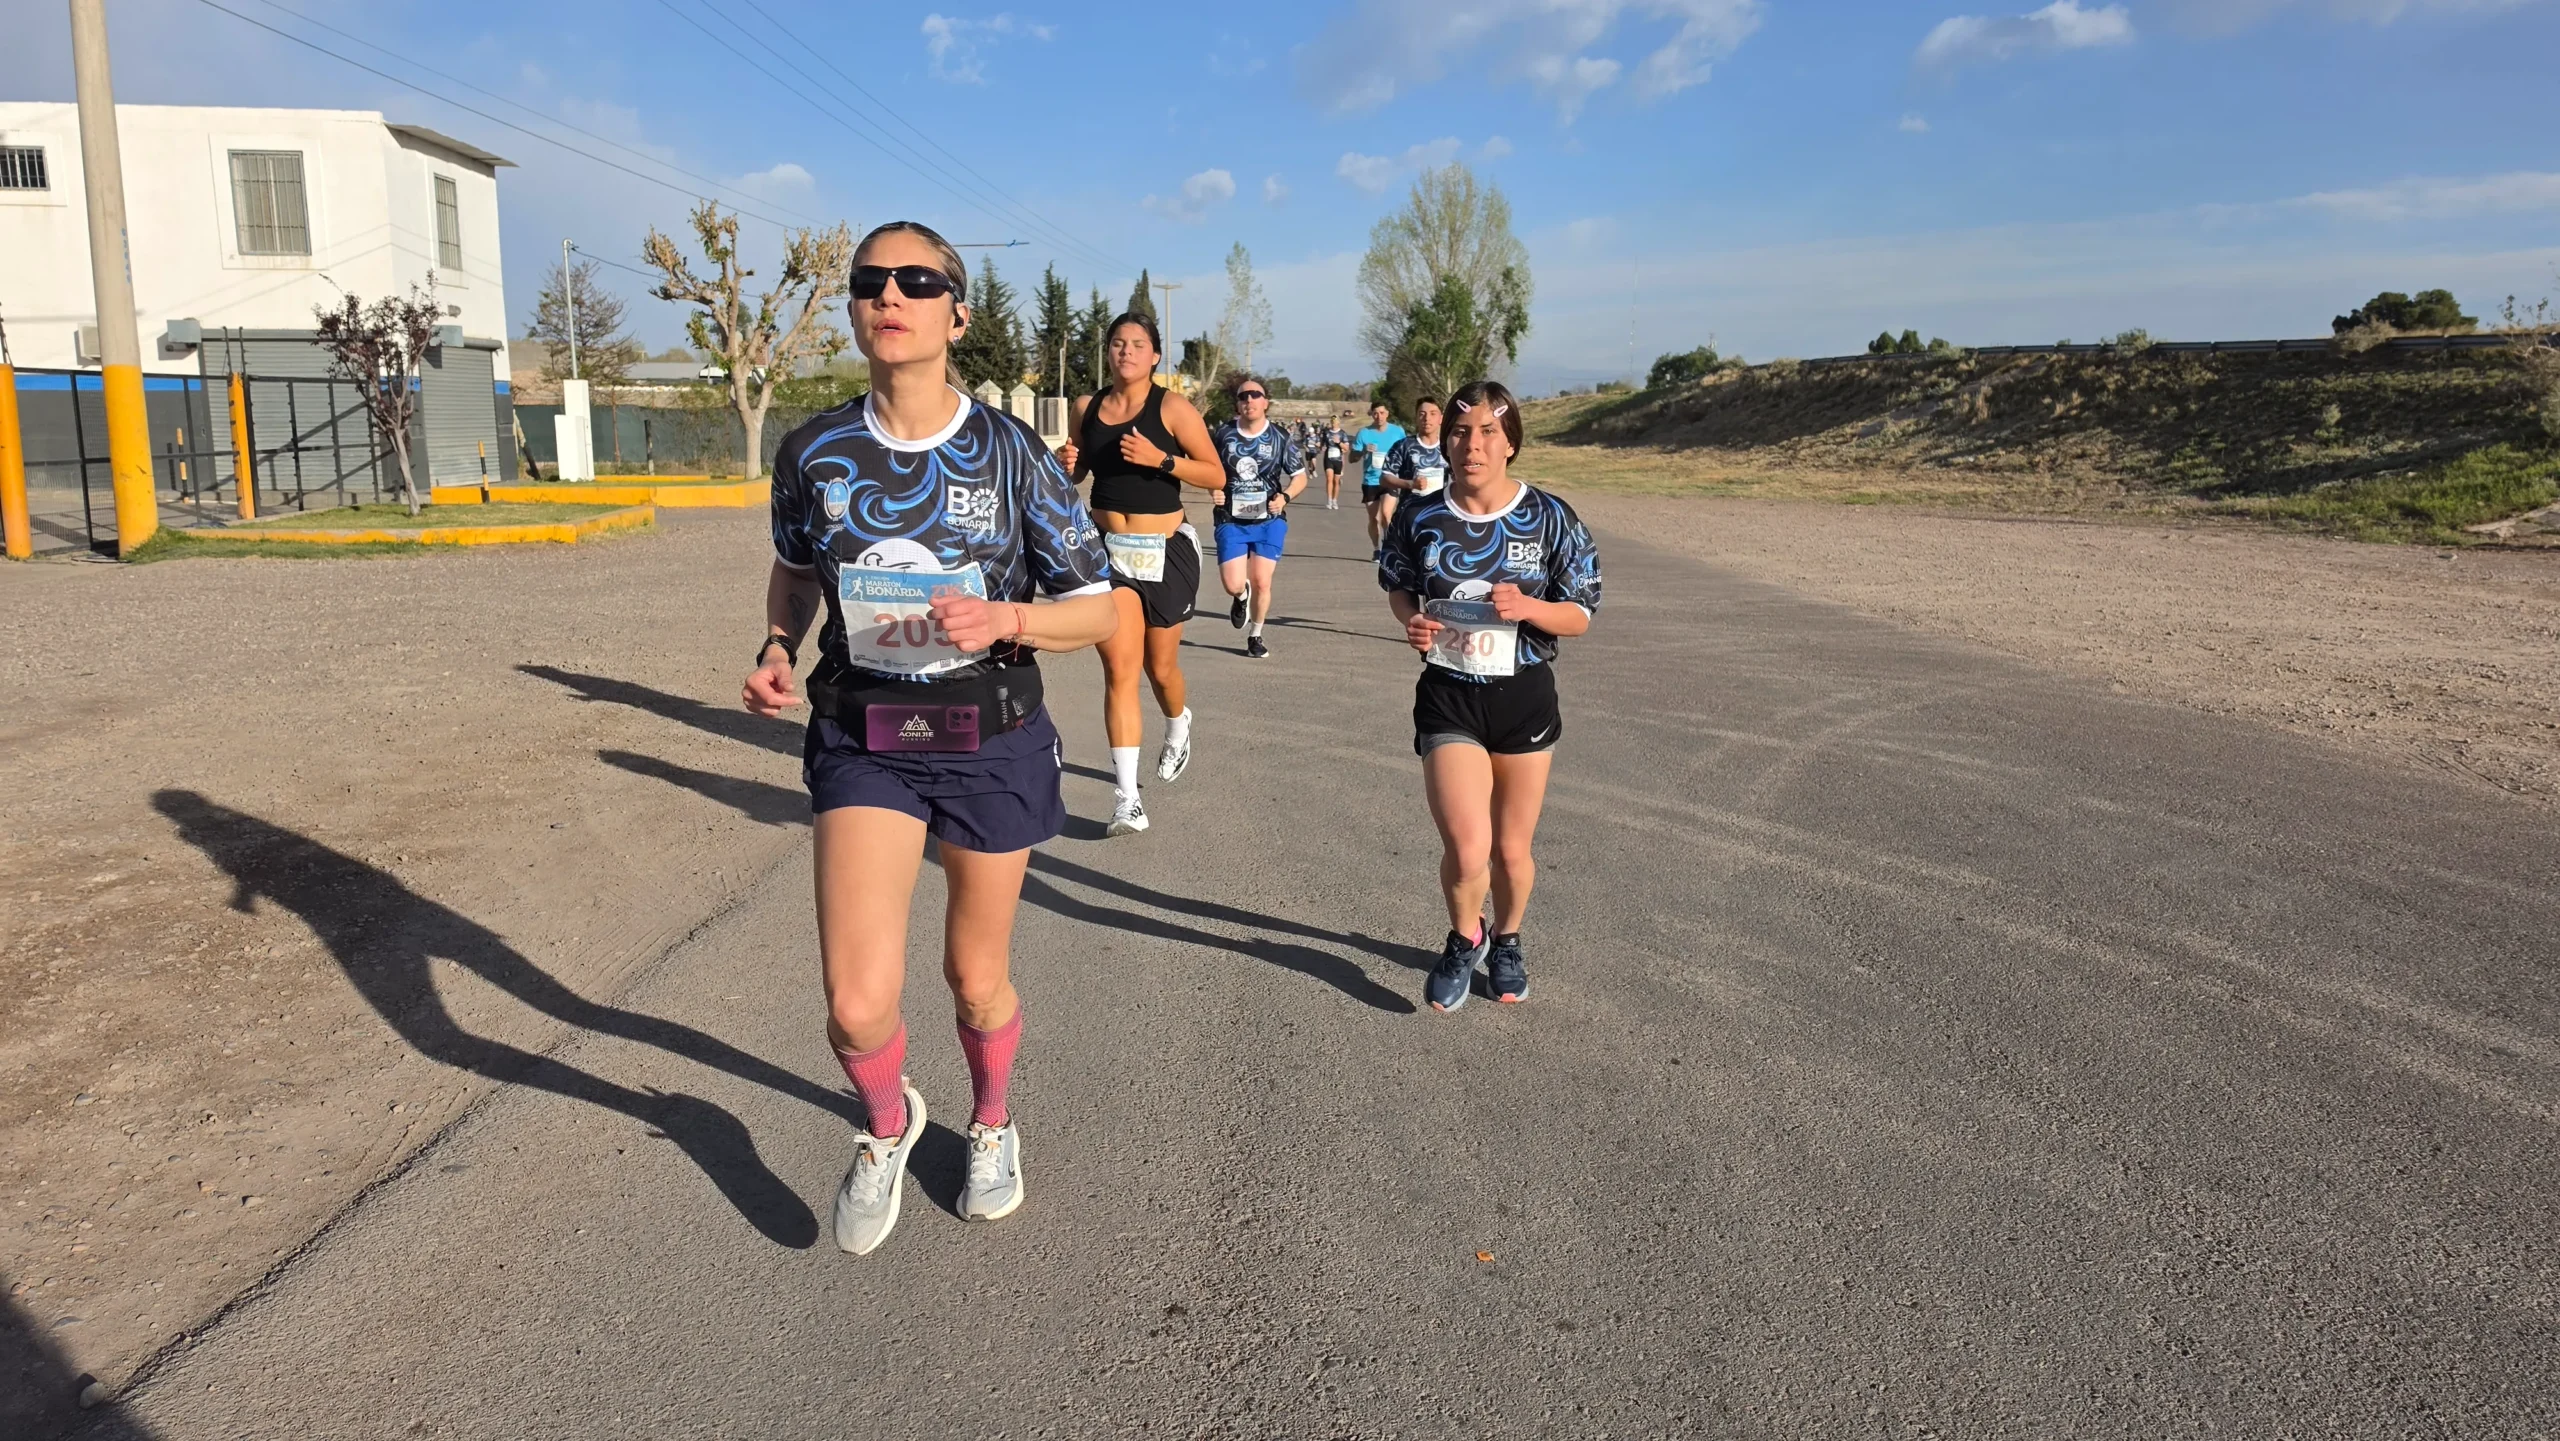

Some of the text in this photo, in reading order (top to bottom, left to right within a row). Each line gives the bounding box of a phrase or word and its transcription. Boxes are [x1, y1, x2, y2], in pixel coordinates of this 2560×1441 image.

[1238, 503, 1260, 514] 204
[947, 516, 997, 530] BONARDA
[865, 580, 901, 588] MARATÓN
[866, 586, 925, 598] BONARDA
[1443, 610, 1478, 621] BONARDA
[1444, 627, 1495, 657] 280
[1000, 701, 1009, 725] NIVEA
